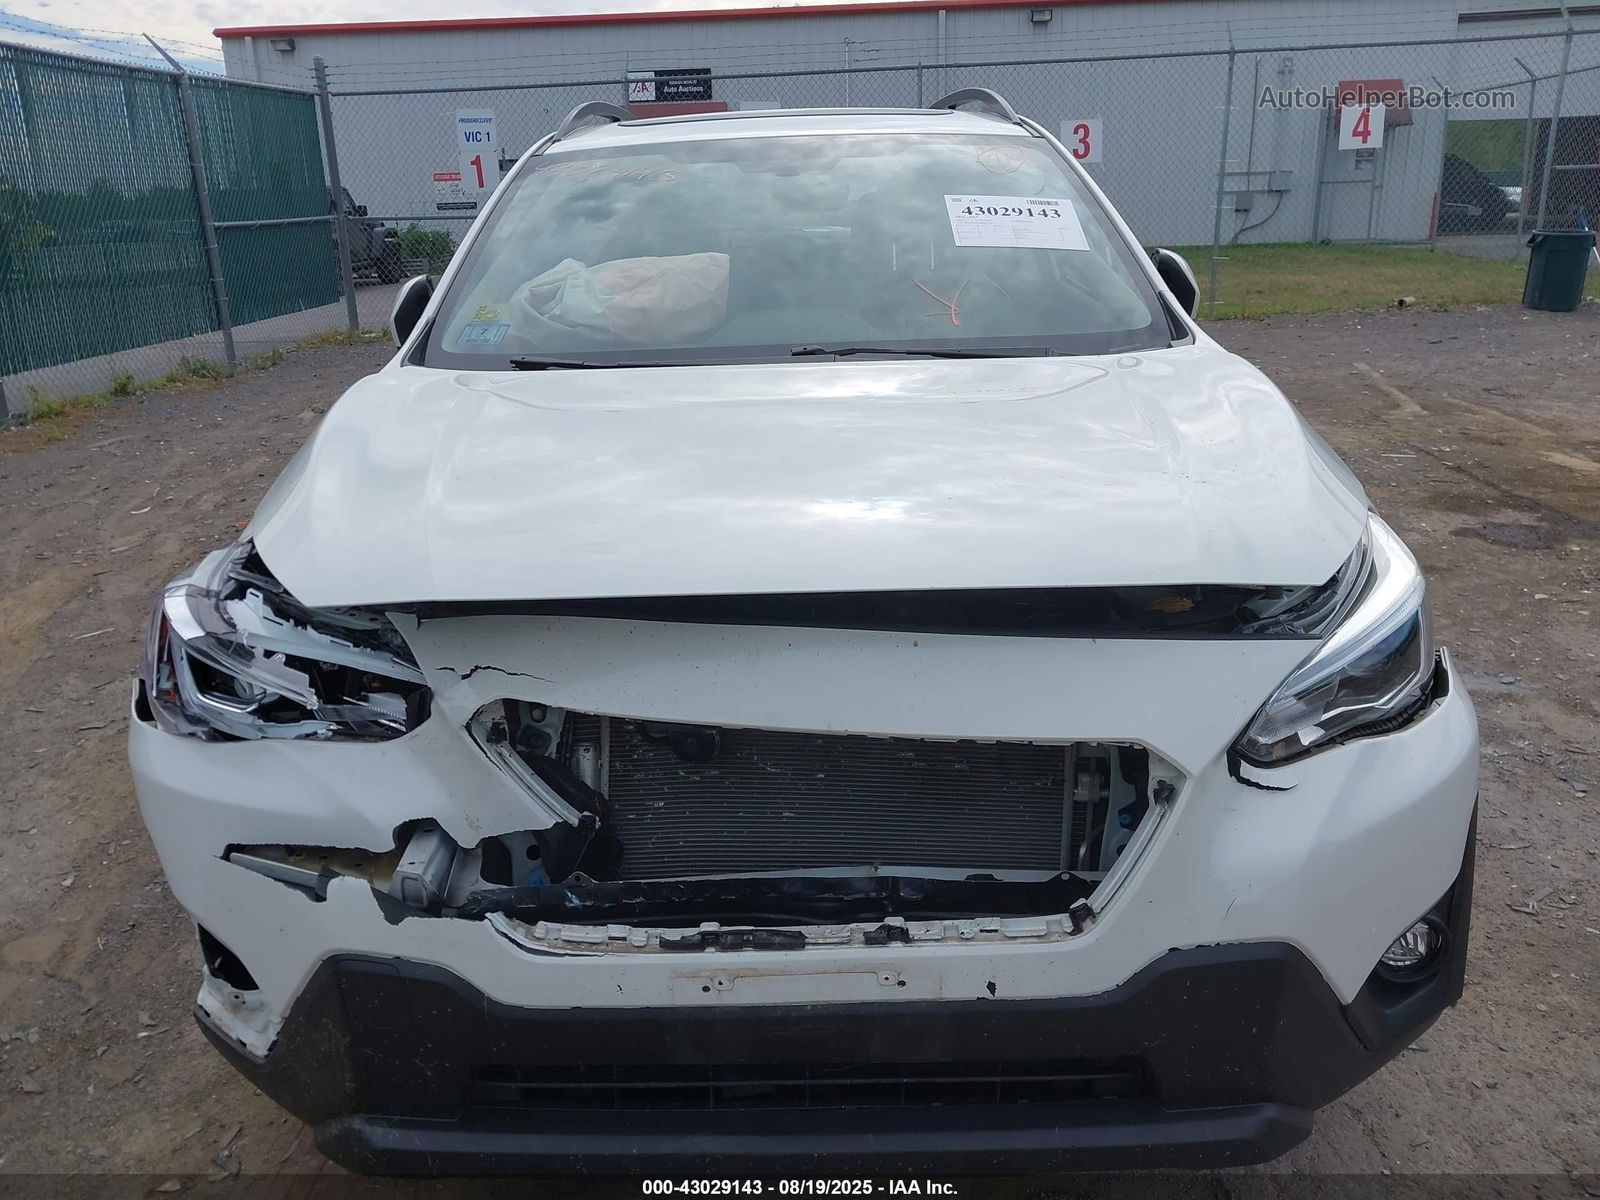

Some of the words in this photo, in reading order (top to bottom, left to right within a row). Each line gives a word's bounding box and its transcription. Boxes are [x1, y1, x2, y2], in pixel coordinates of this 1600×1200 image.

[678, 85, 704, 93] Auctions
[464, 131, 482, 143] VIC
[485, 131, 491, 142] 1
[1351, 107, 1371, 144] 4
[1072, 123, 1091, 160] 3
[470, 154, 485, 188] 1
[961, 206, 1062, 219] 43029143
